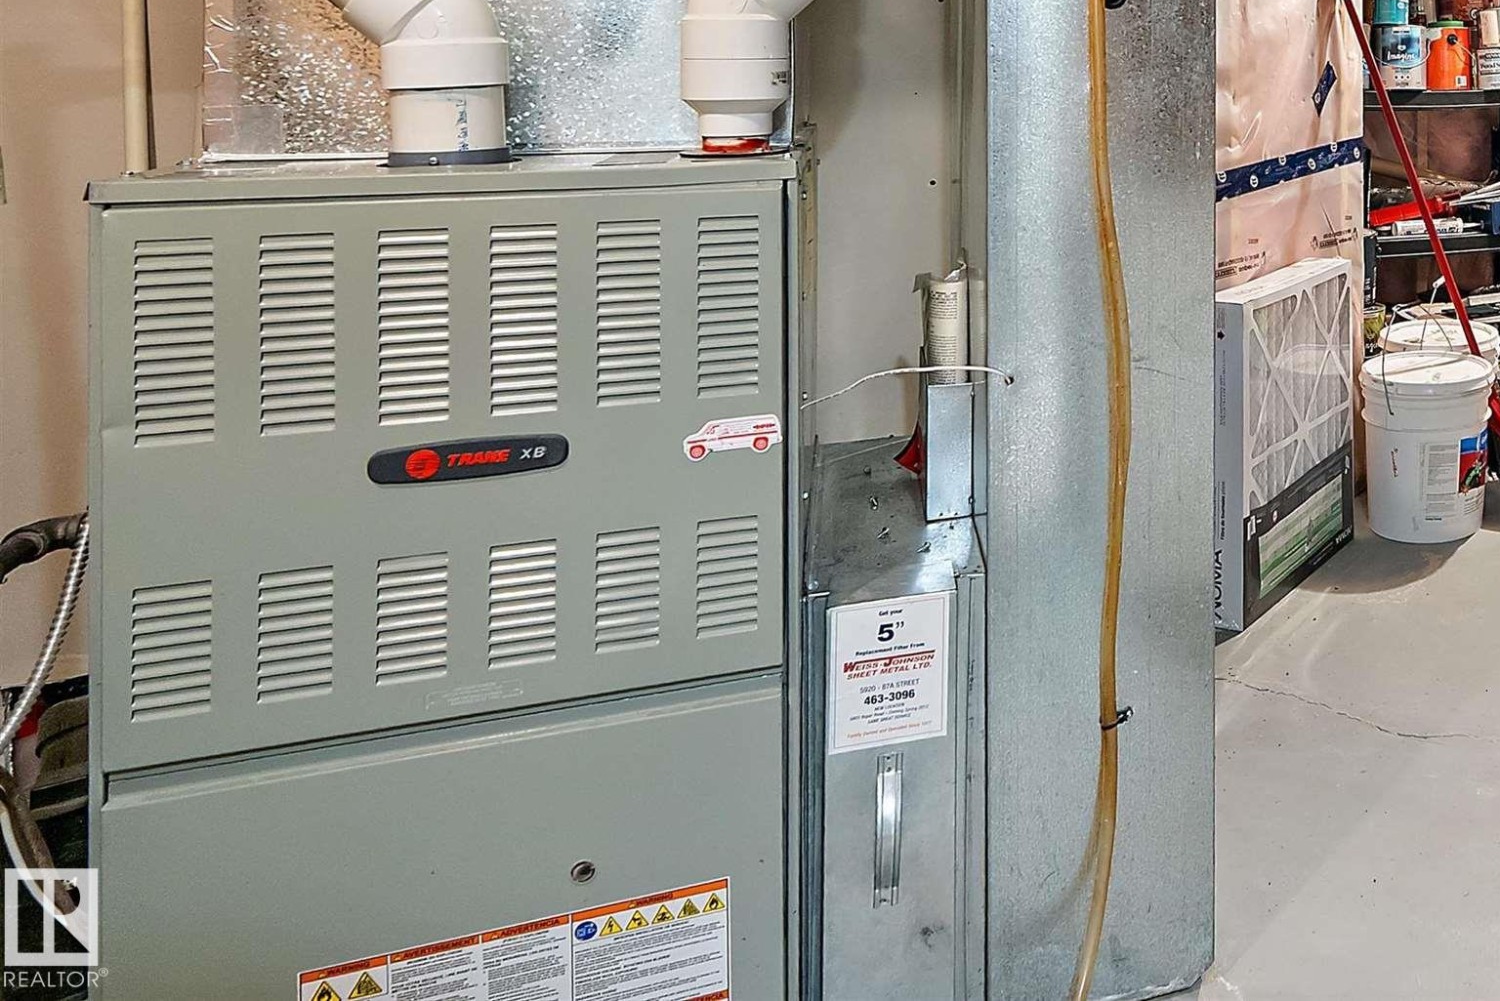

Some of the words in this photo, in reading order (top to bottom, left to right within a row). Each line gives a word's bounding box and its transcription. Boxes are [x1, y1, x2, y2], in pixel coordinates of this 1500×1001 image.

[447, 448, 512, 468] TRANE
[519, 446, 548, 460] XB
[847, 669, 877, 680] SHEET
[880, 665, 909, 675] METAL
[913, 661, 932, 669] LTD.
[896, 678, 920, 687] STREET
[864, 689, 915, 705] 463-3096
[403, 937, 476, 960] AVERTISSEMENT
[326, 961, 371, 977] WARNING
